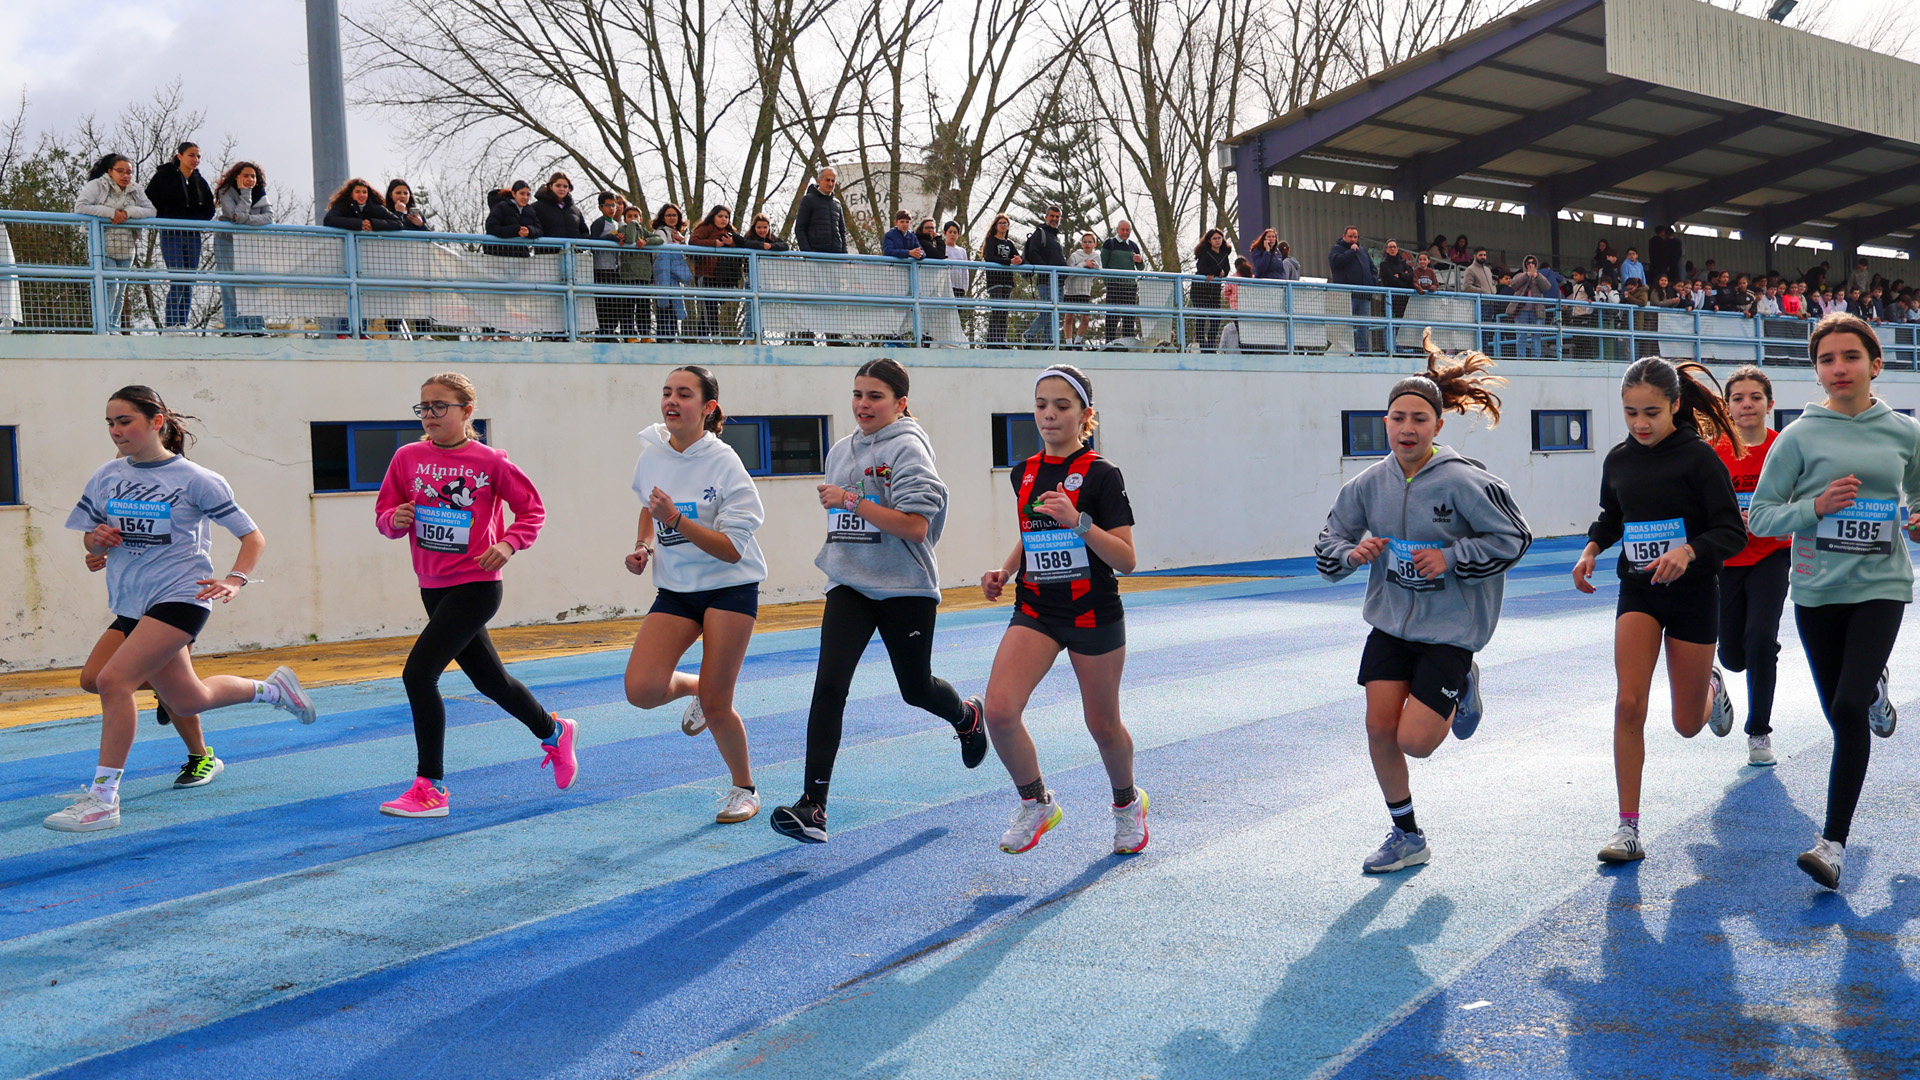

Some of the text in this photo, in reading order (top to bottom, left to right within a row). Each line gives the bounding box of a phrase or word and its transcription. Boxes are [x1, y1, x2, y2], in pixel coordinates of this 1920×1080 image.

[415, 463, 474, 477] Minnie
[107, 479, 183, 508] Stitch
[110, 501, 166, 512] VENDAS NOVAS
[416, 507, 467, 520] VENDAS NOVAS
[1865, 502, 1894, 512] NOVAS
[119, 517, 155, 533] 1547
[836, 514, 866, 531] 1551
[1650, 521, 1680, 532] NOVAS
[1836, 519, 1882, 540] 1585
[422, 523, 455, 542] 1504
[1023, 531, 1079, 543] VENDAS NOVAS
[1644, 531, 1675, 539] DESPORTO
[1633, 541, 1670, 560] 1587
[1034, 550, 1072, 570] 1589
